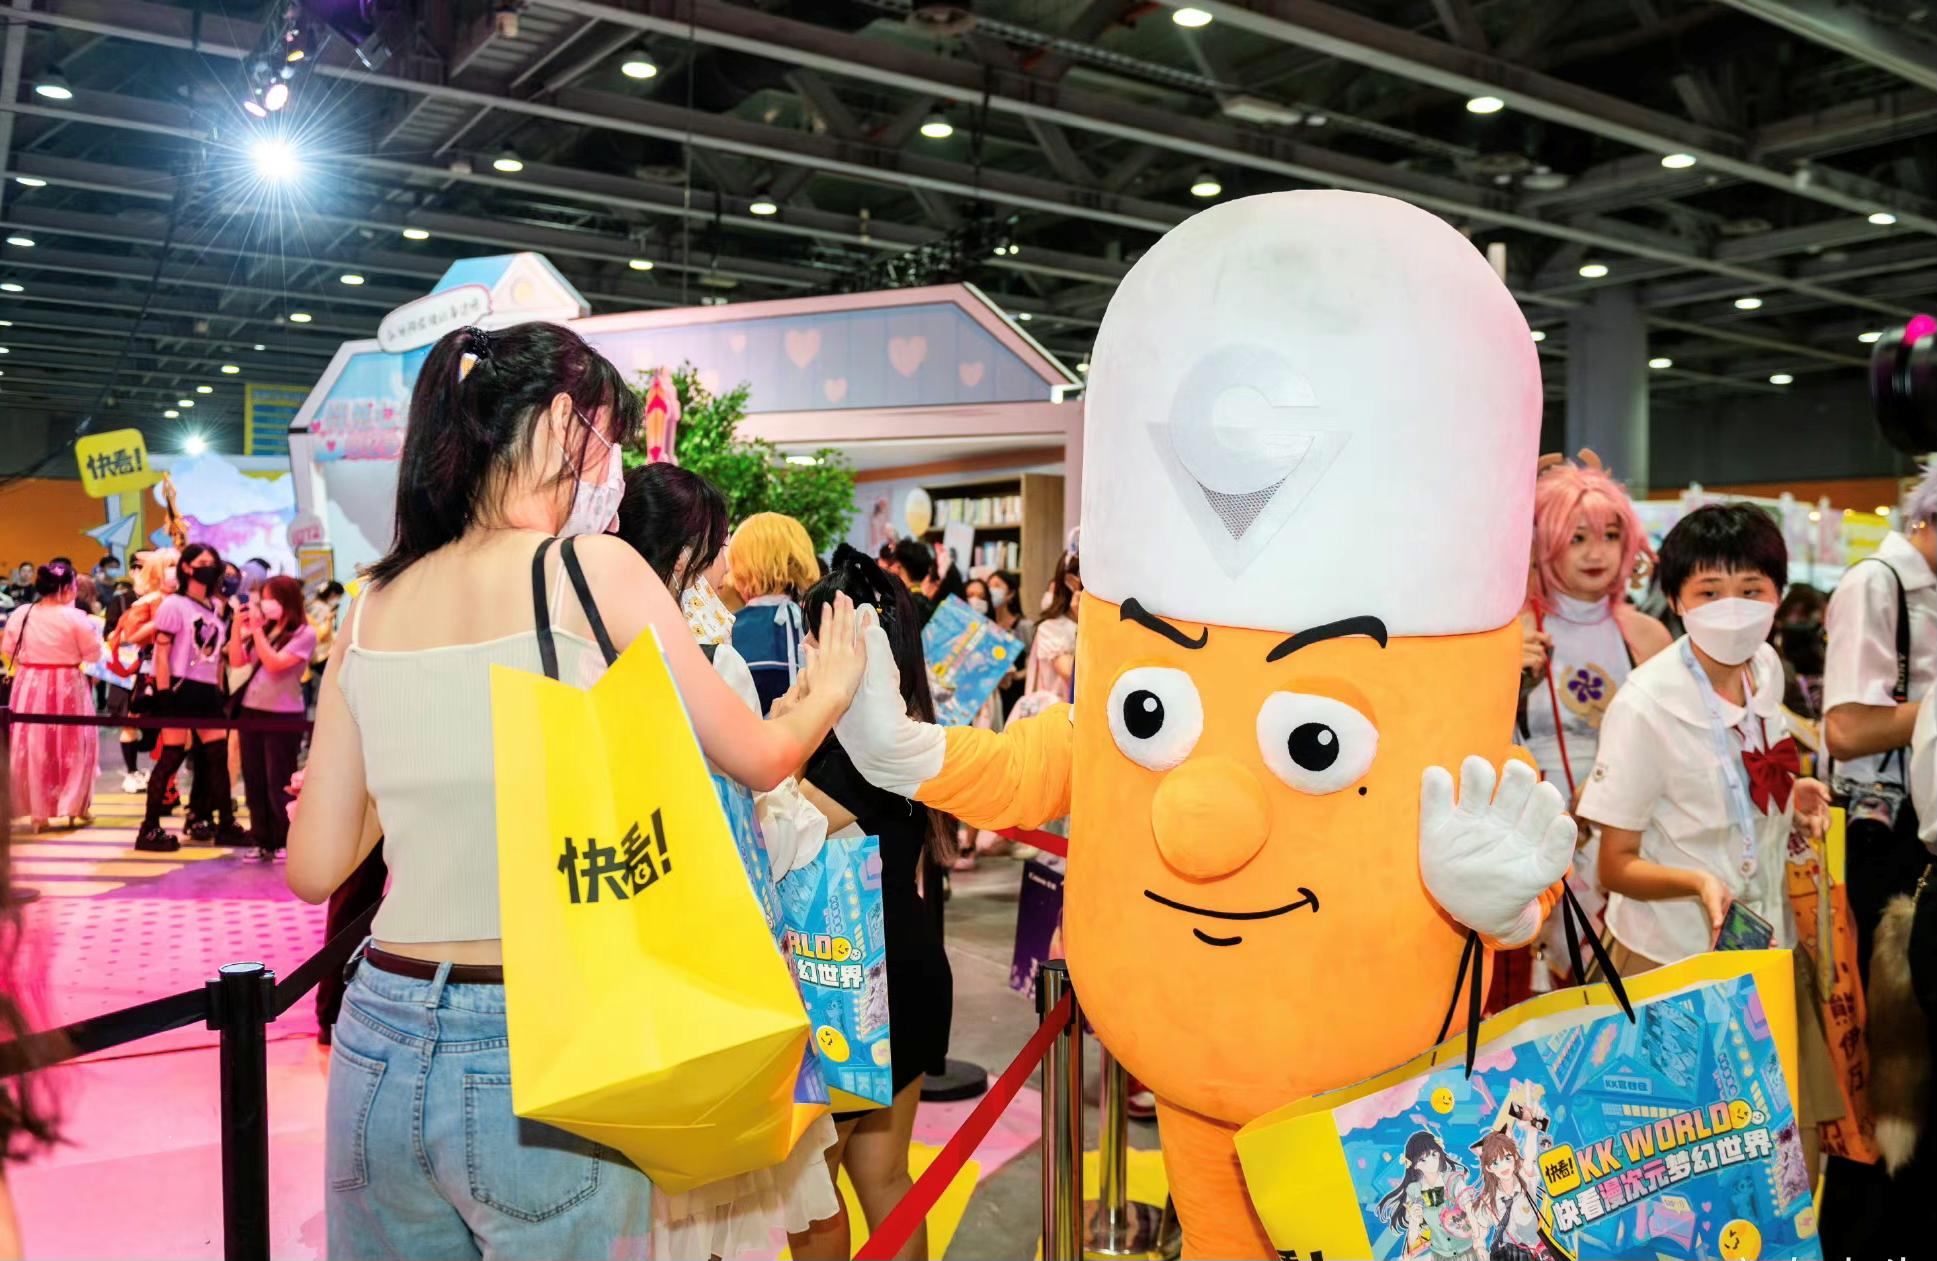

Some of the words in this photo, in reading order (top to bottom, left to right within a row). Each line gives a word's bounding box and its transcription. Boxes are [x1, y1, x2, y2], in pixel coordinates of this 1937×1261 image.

[86, 447, 143, 481] 快看!
[556, 805, 672, 905] 快看!
[787, 930, 832, 961] RLD
[797, 959, 864, 990] 幻世界
[1577, 1138, 1622, 1184] KK
[1620, 1101, 1735, 1164] WORLD
[1545, 1157, 1575, 1185] 快看!
[1551, 1126, 1774, 1233] 快看漫次元梦幻世界
